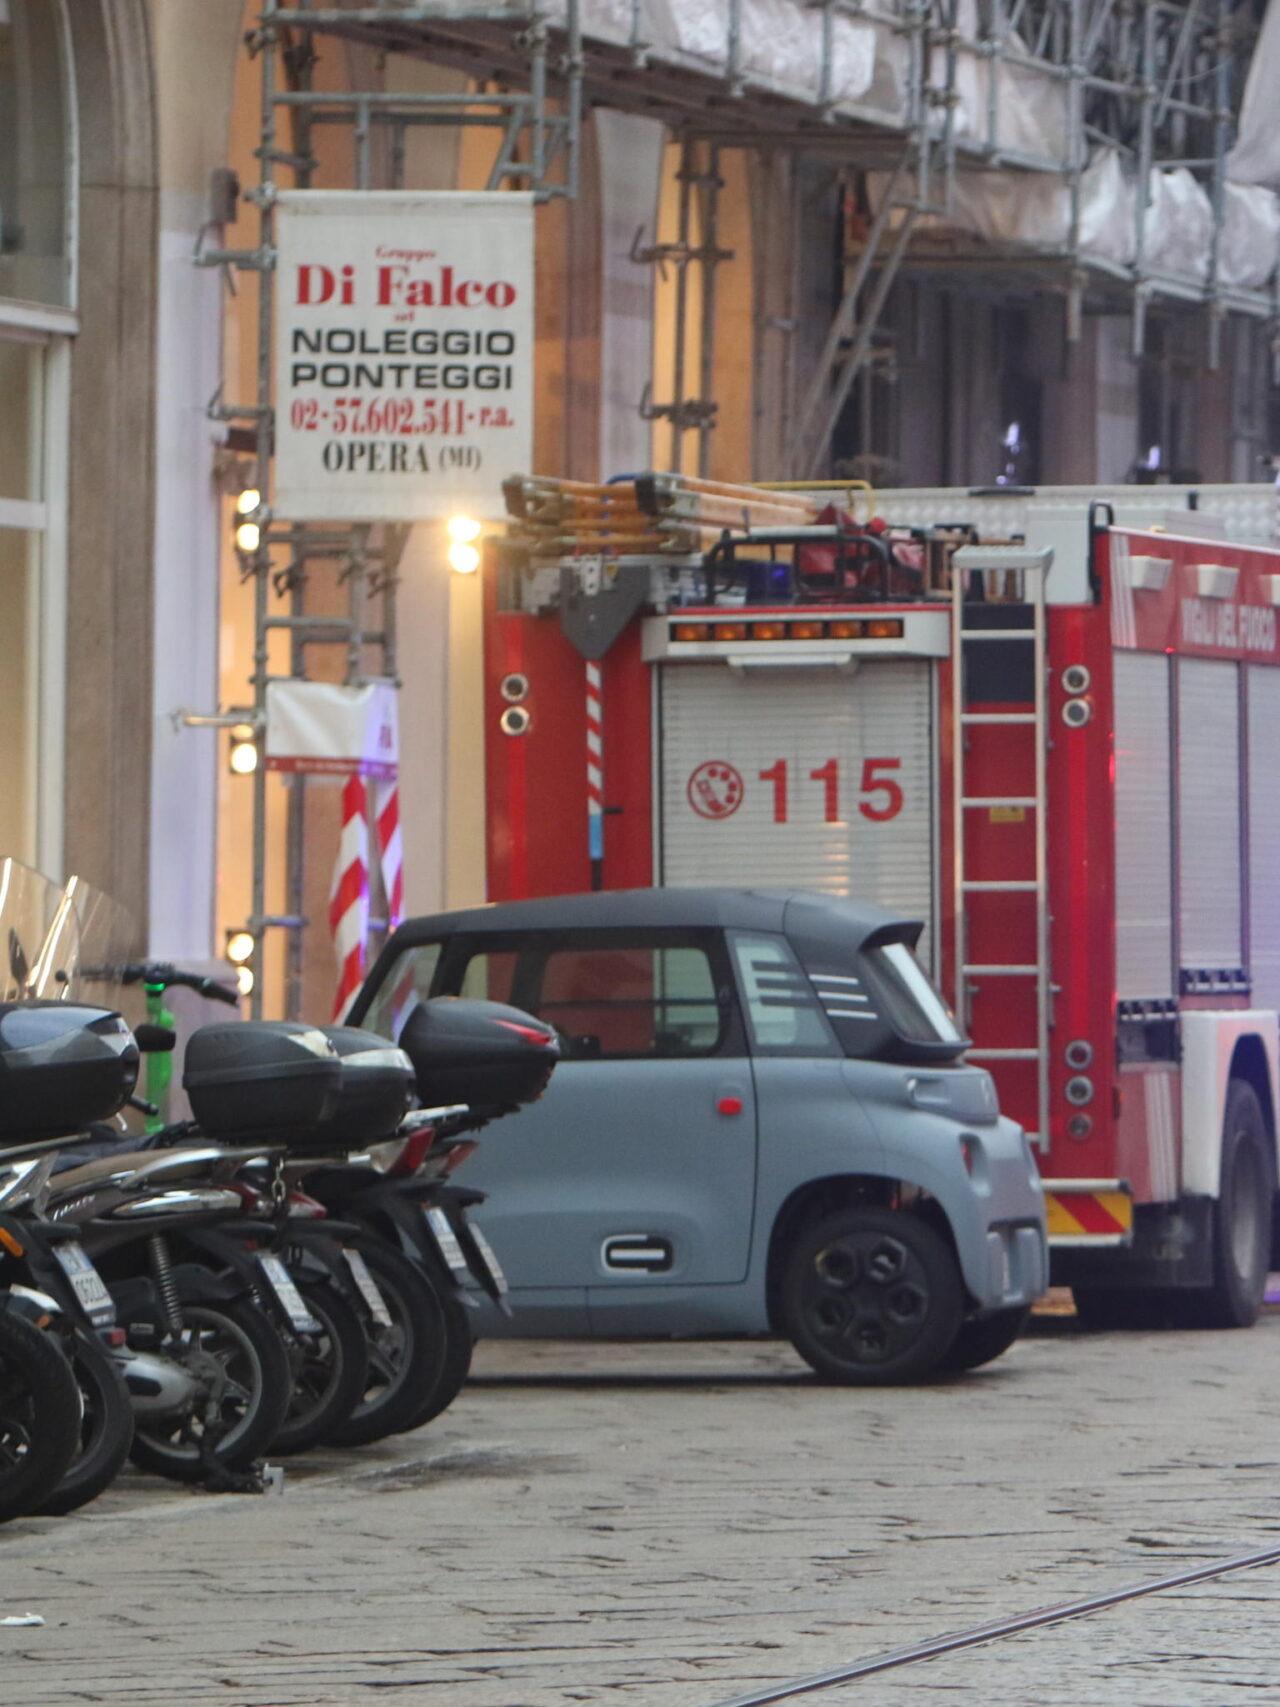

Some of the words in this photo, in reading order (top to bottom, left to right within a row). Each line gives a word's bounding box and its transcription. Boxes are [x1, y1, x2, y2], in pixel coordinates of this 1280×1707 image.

[296, 264, 356, 305] Di
[376, 265, 517, 308] Falco
[292, 328, 515, 356] NOLEGGIO
[292, 362, 513, 390] PONTEGGI
[322, 439, 430, 472] OPERA
[438, 445, 482, 472] (MI)
[759, 758, 904, 824] 115
